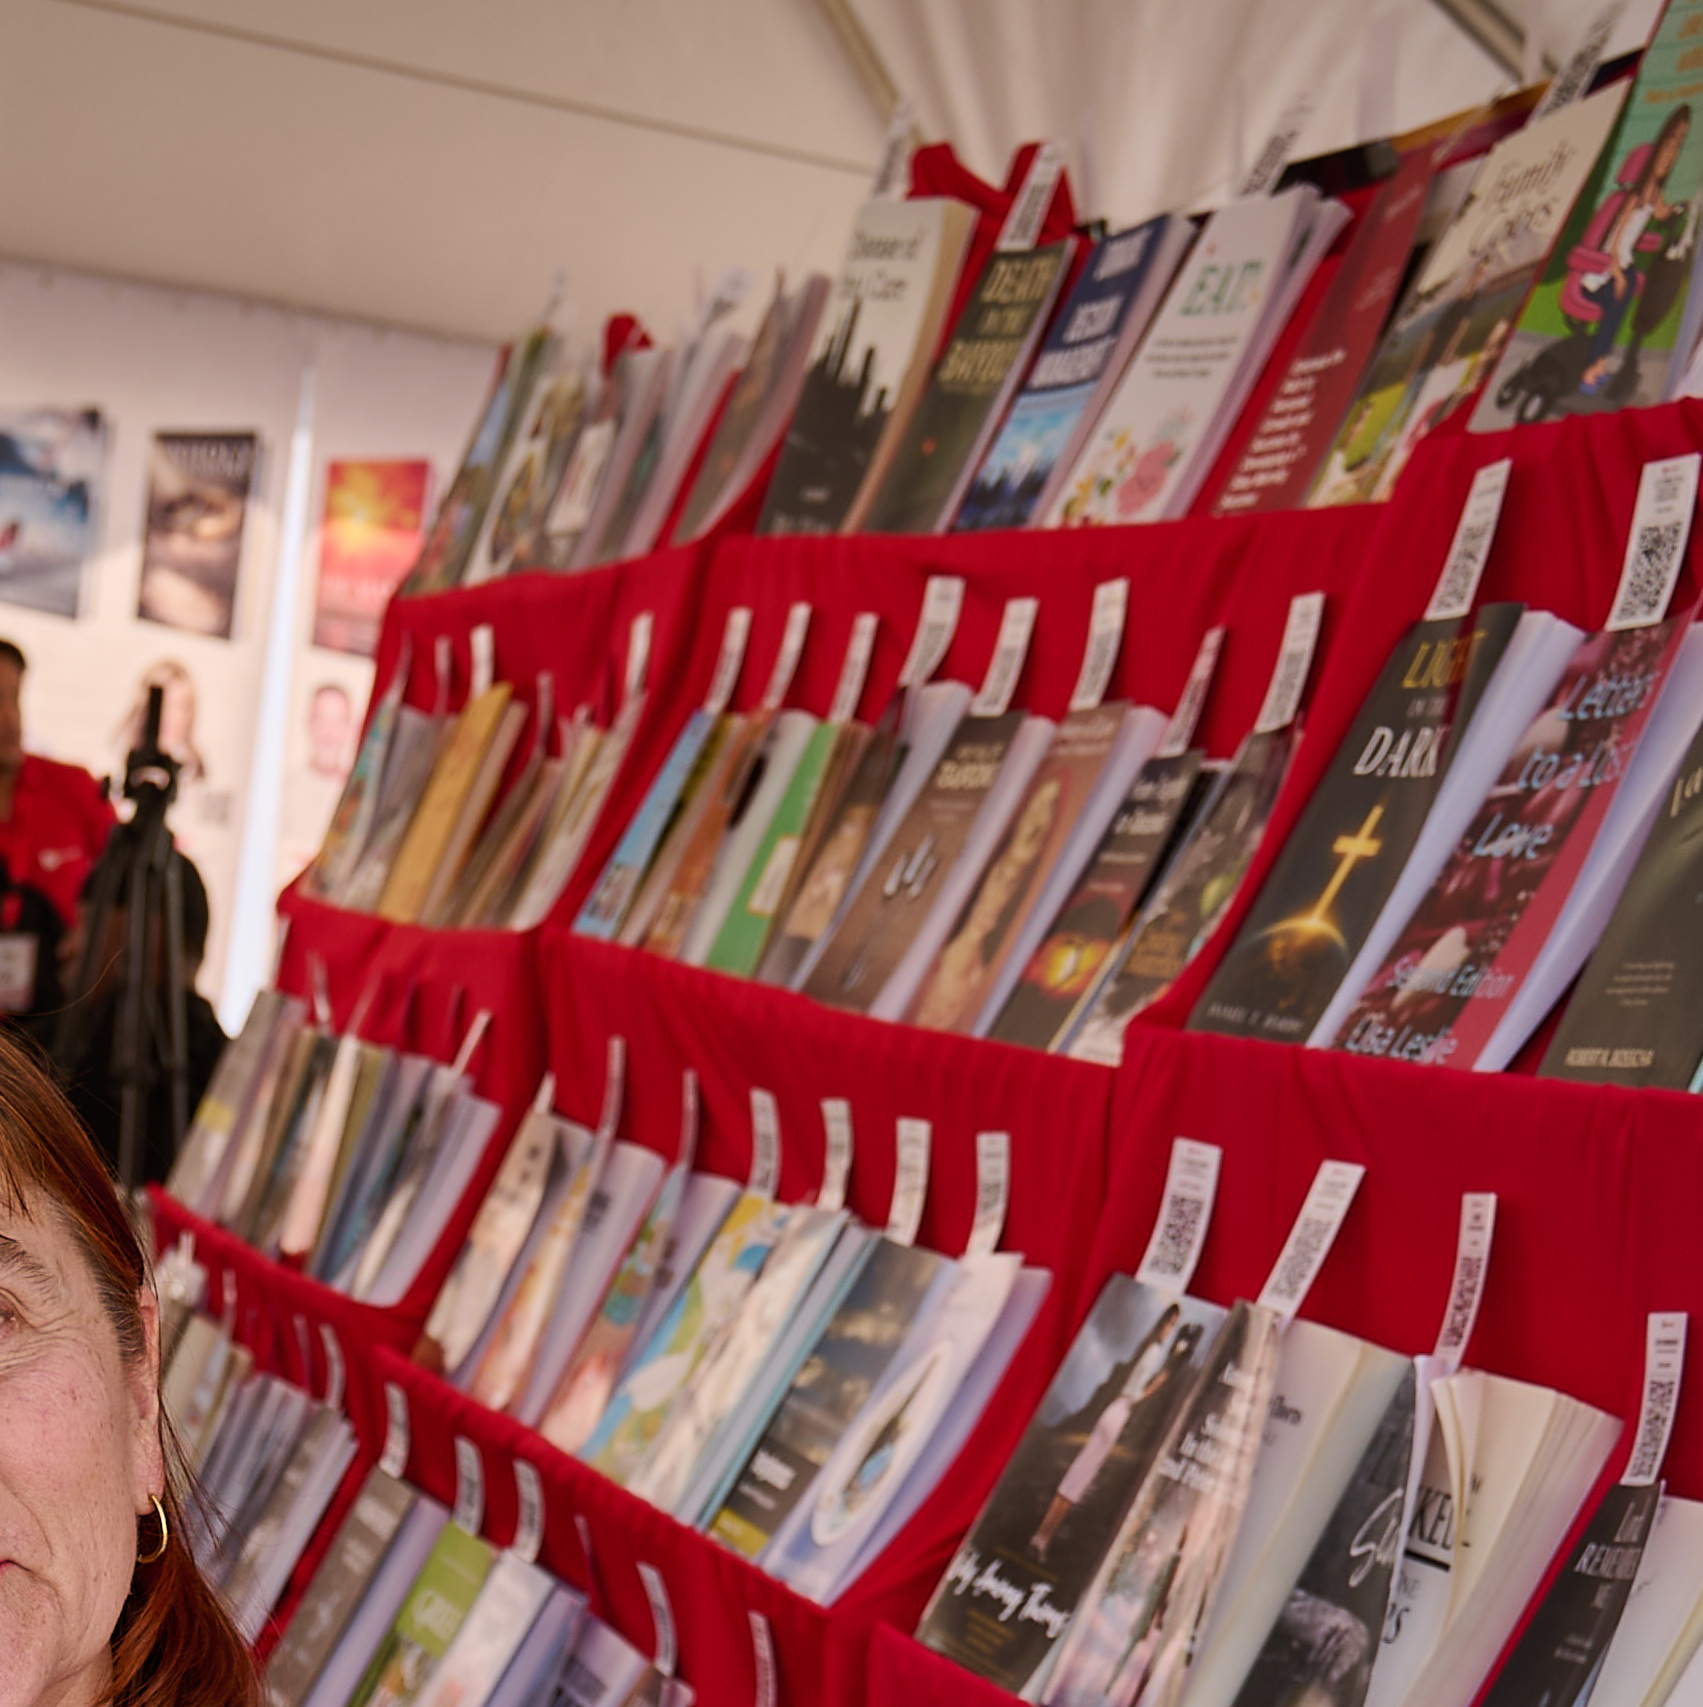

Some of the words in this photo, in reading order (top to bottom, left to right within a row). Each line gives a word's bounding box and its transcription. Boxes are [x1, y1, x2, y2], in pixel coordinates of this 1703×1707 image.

[1352, 724, 1449, 778] DARK
[1517, 744, 1559, 790] to
[1557, 752, 1584, 790] a
[1475, 811, 1552, 862] Love
